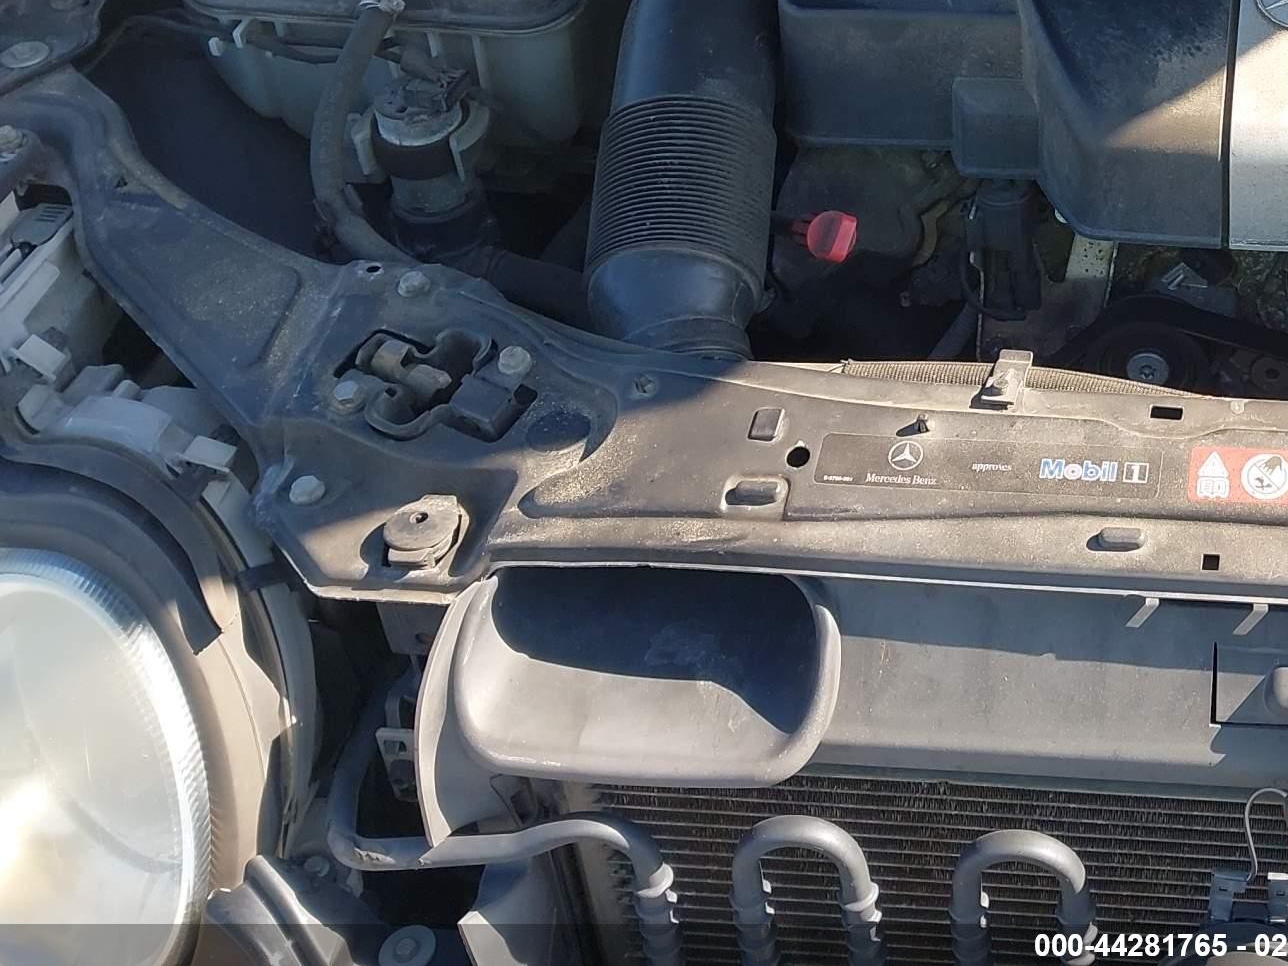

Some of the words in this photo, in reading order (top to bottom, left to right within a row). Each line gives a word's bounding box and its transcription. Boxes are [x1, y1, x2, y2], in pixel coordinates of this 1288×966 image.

[865, 472, 911, 485] Mercedes
[911, 475, 937, 485] Benz
[971, 462, 1013, 473] approves
[1038, 458, 1119, 482] Mobil
